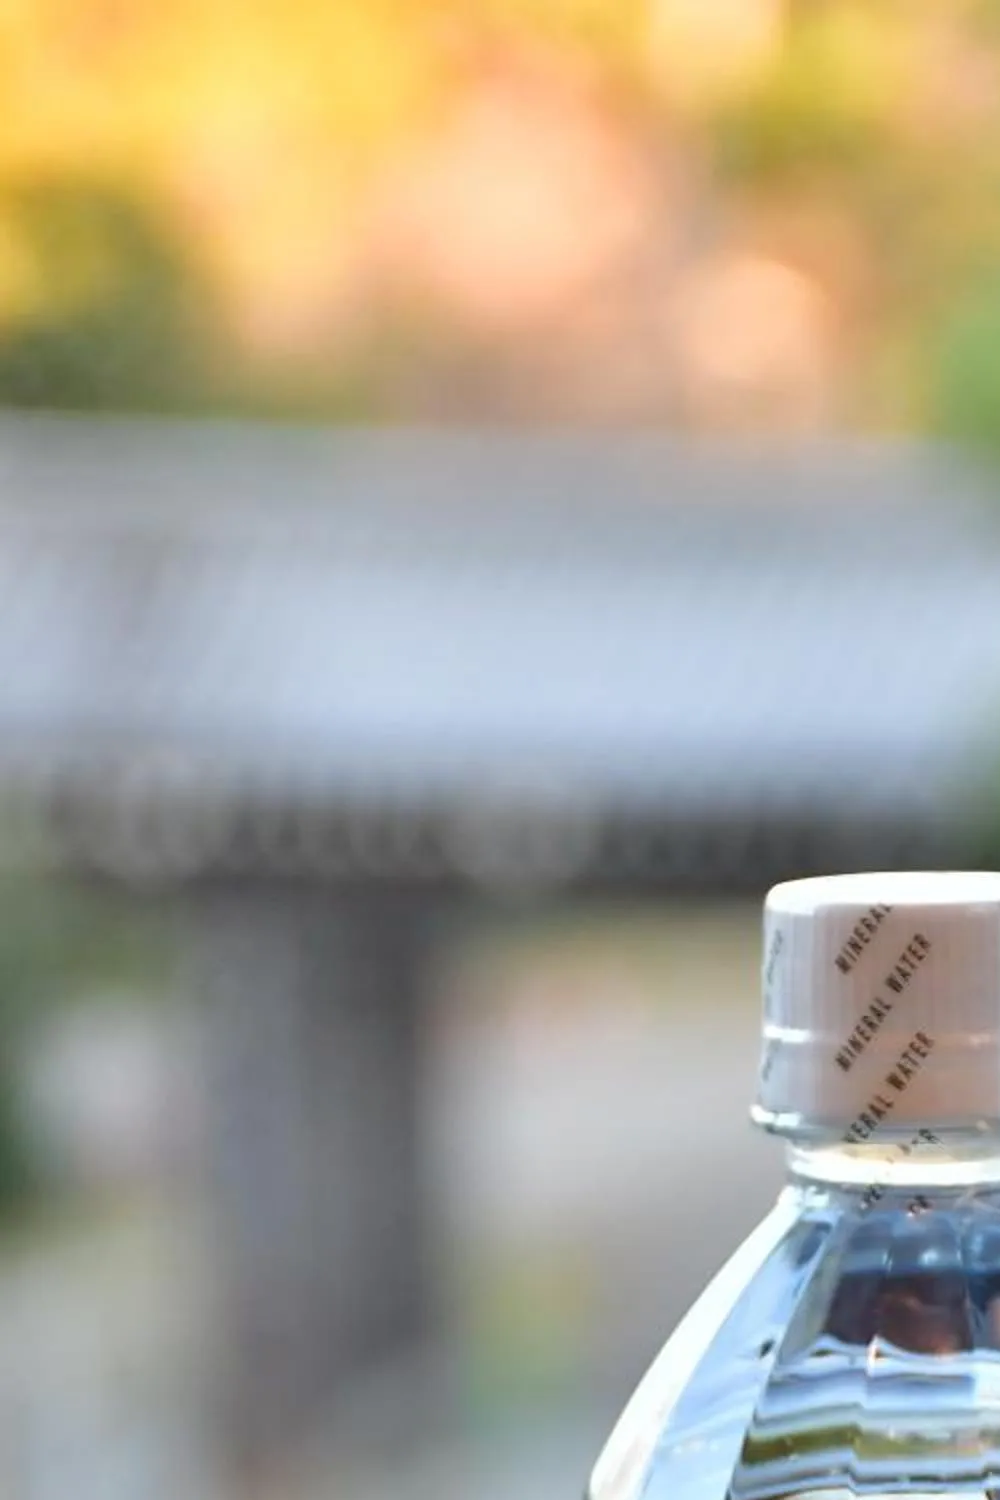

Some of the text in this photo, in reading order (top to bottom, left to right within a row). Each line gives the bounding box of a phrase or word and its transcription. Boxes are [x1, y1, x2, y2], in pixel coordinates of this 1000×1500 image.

[834, 902, 893, 974] MINERAL
[834, 932, 931, 1072] MINERAL WATER
[885, 1031, 936, 1093] WATER
